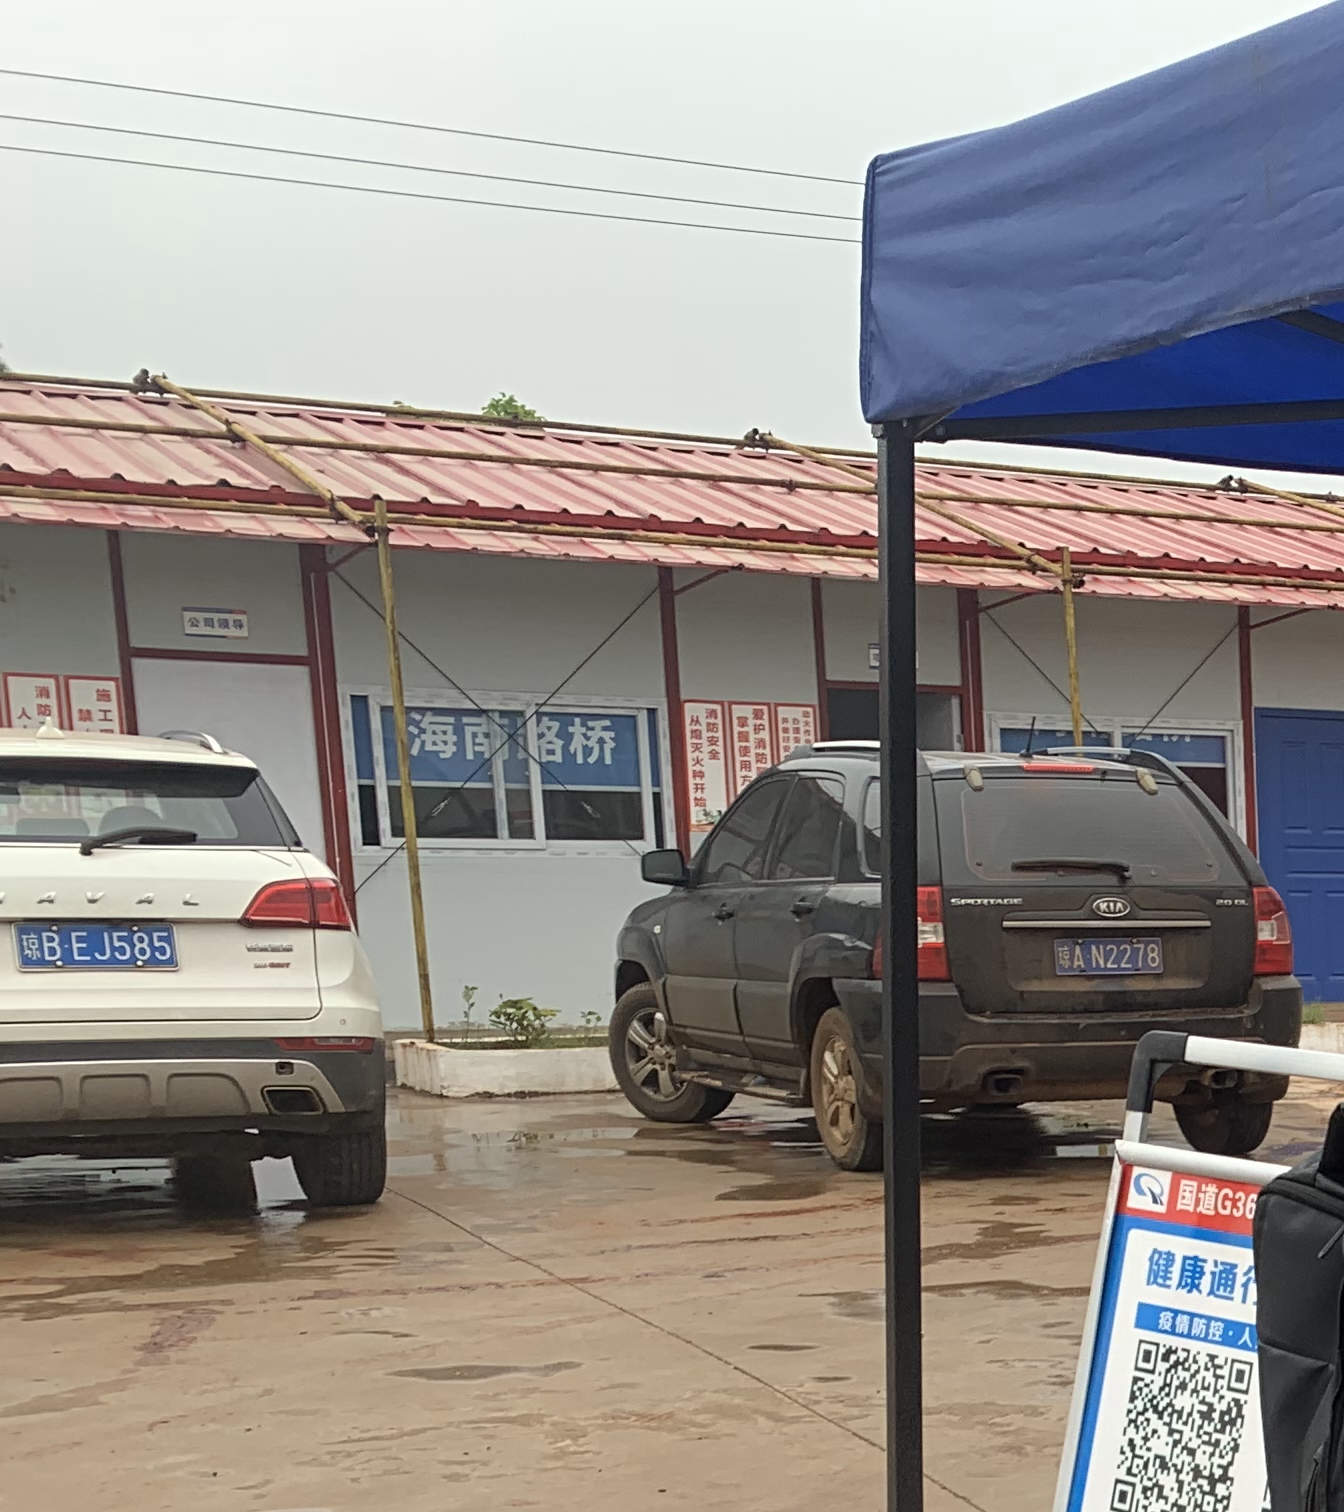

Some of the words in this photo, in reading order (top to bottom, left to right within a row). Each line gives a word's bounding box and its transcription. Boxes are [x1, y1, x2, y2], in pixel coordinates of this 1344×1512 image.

[187, 617, 245, 630] 公司领导
[408, 711, 616, 765] 海南路桥
[705, 708, 721, 761] 消防安全
[0, 891, 199, 906] AVAL
[950, 898, 1023, 906] SPORTAGE
[1099, 902, 1125, 912] KIA
[1158, 1311, 1258, 1349] 疫情防控·人
